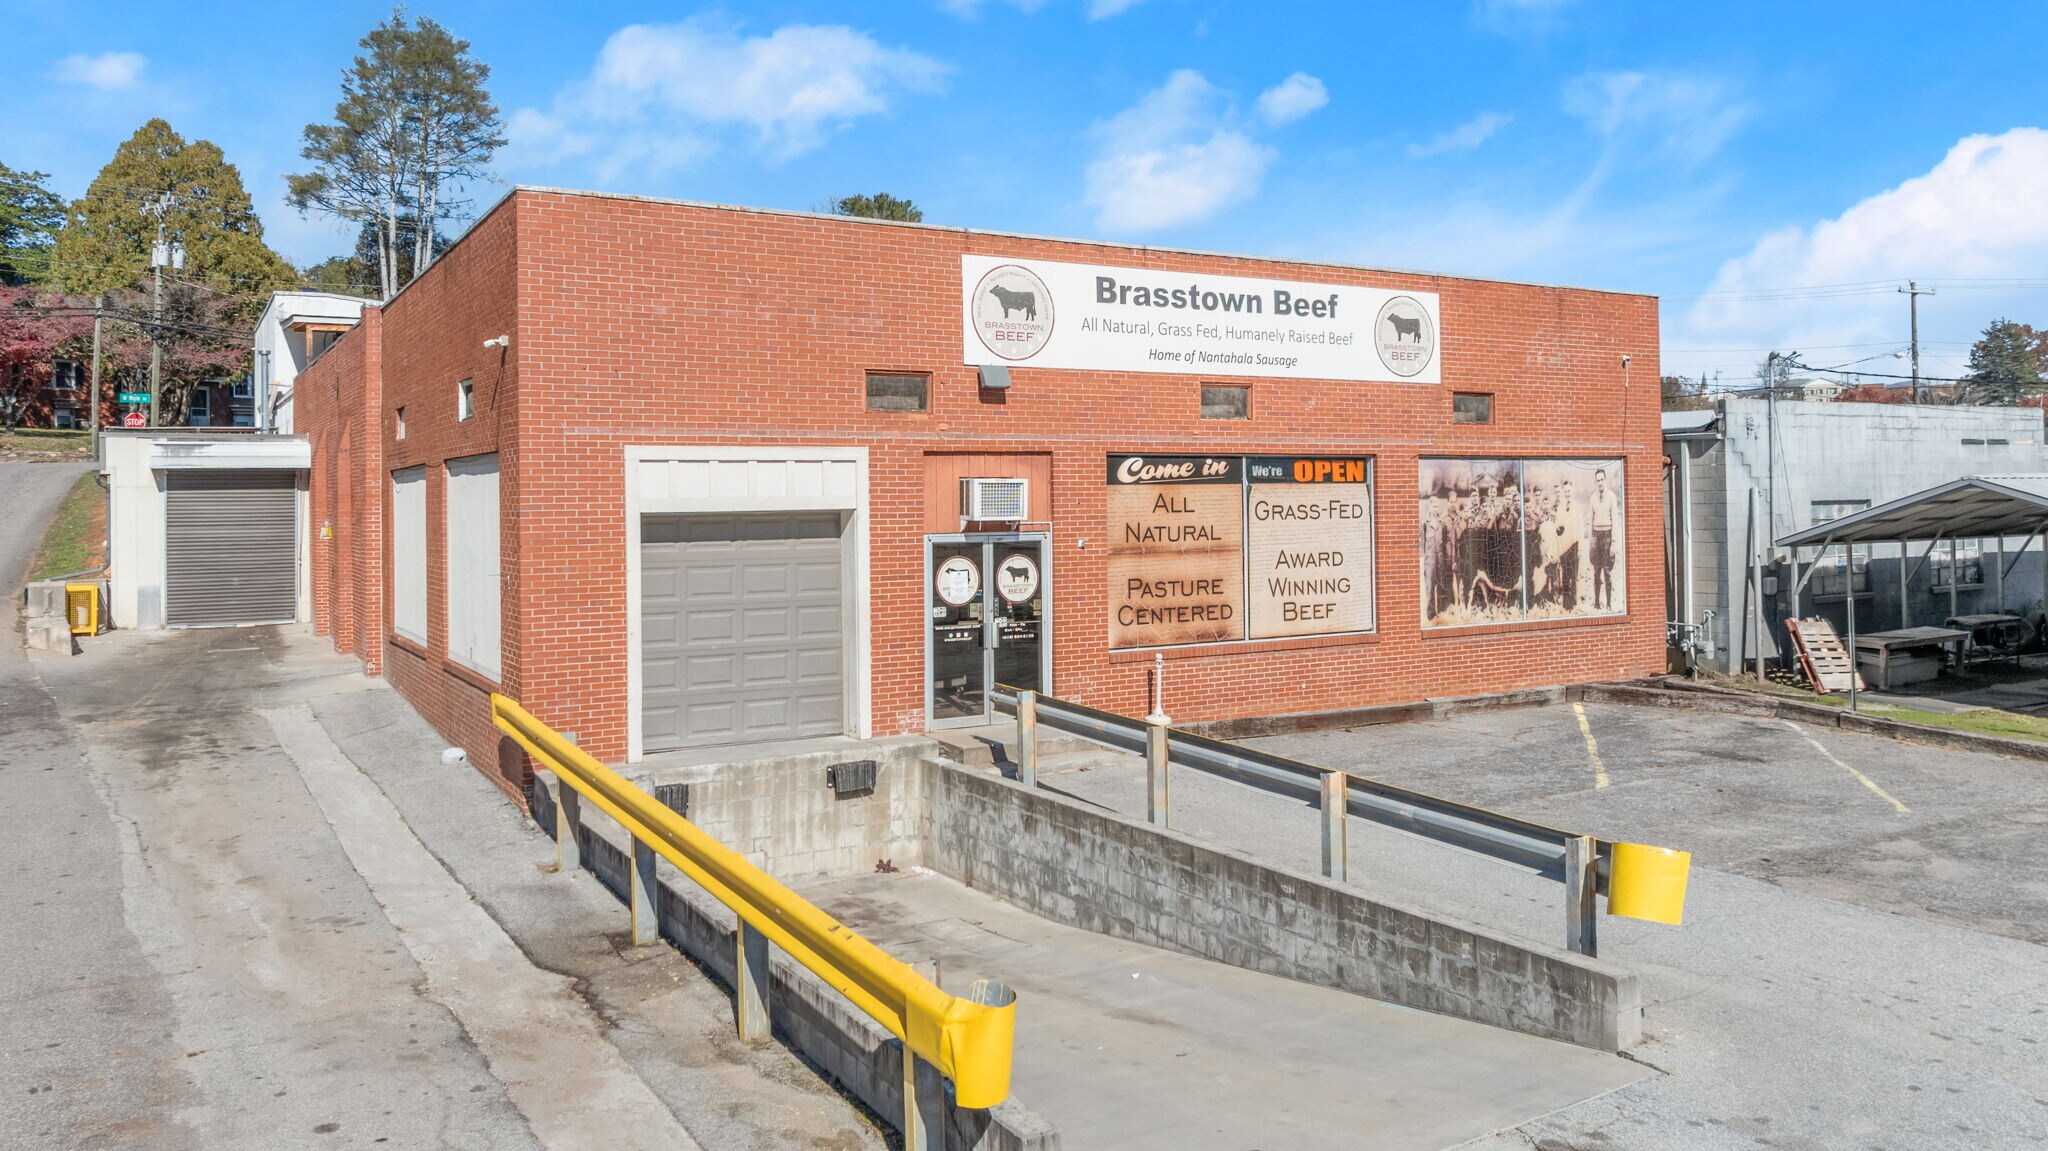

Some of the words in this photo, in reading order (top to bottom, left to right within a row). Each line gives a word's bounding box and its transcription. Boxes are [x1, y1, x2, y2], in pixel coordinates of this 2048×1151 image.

[1096, 276, 1262, 314] Brasstown
[1273, 290, 1338, 318] Beef
[984, 321, 1044, 331] BRASSTOWN
[995, 330, 1035, 342] BEEF
[1081, 317, 1098, 332] All
[1102, 318, 1154, 338] Natural,
[1158, 321, 1192, 337] Grass
[1196, 323, 1222, 340] Fed,
[1226, 325, 1285, 344] Humanely
[1288, 329, 1325, 344] Raised
[1328, 331, 1354, 346] Beef
[1383, 343, 1427, 352] BRASSTOWN
[1391, 351, 1421, 361] BEEF
[1148, 348, 1181, 361] Home
[1184, 350, 1197, 365] of
[1198, 351, 1253, 365] Nantahala
[1255, 353, 1298, 369] Sausage
[1117, 457, 1195, 483] Come
[1201, 458, 1230, 477] in
[1252, 465, 1283, 477] We're
[1293, 460, 1364, 483] OPEN
[1152, 493, 1196, 514] ALL
[1254, 500, 1363, 521] GRASS-FED
[1125, 523, 1222, 543] NATURAL
[1275, 550, 1344, 570] AWARD
[1008, 587, 1029, 595] BEEF
[1127, 578, 1224, 599] PASTURE
[1268, 577, 1351, 597] WINNING
[1117, 604, 1233, 626] CENTERED
[1283, 602, 1337, 622] BEEF
